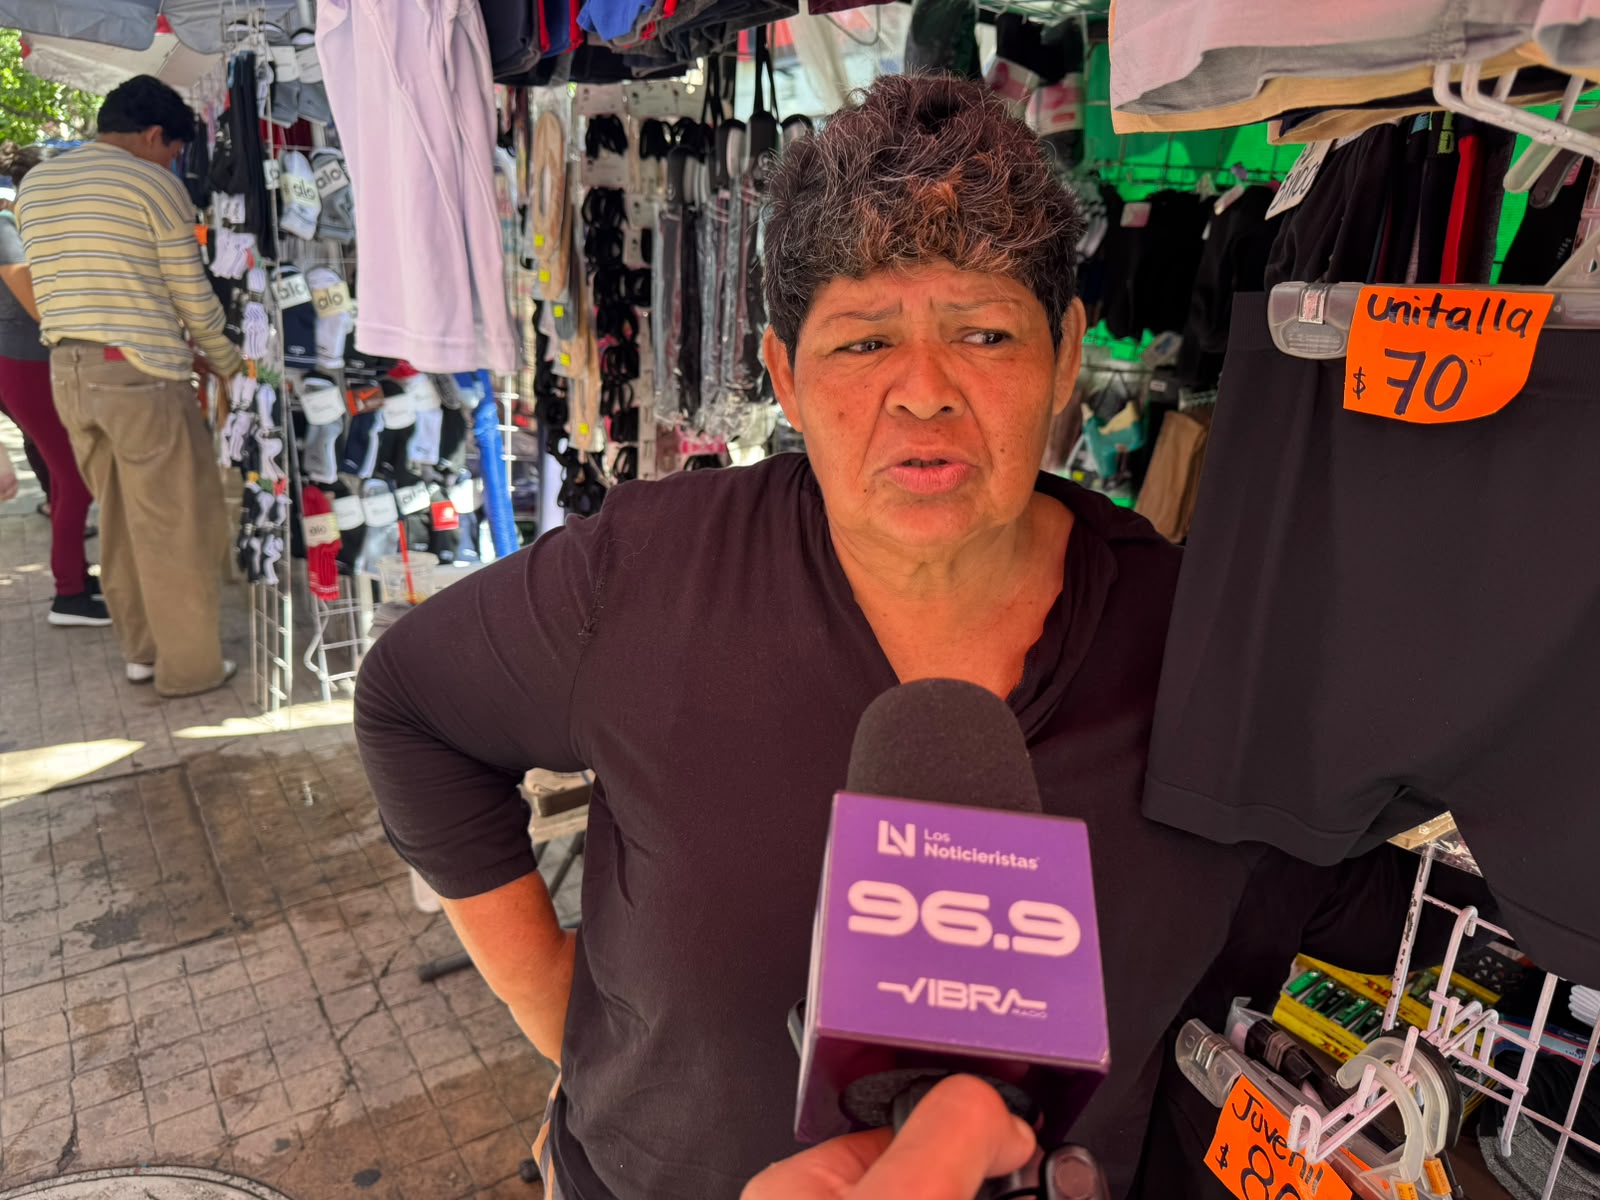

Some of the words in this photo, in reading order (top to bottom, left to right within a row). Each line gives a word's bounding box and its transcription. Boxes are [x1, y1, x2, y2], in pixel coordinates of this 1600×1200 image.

[293, 180, 316, 201] alo
[316, 168, 342, 190] alo
[278, 280, 306, 300] alo
[319, 292, 344, 310] alo
[1366, 292, 1535, 338] unitalla
[1384, 347, 1469, 416] 70
[923, 828, 951, 843] Los
[923, 841, 1040, 871] Noticieristas
[848, 879, 1082, 957] 96.9
[877, 976, 1048, 1015] VIBRA
